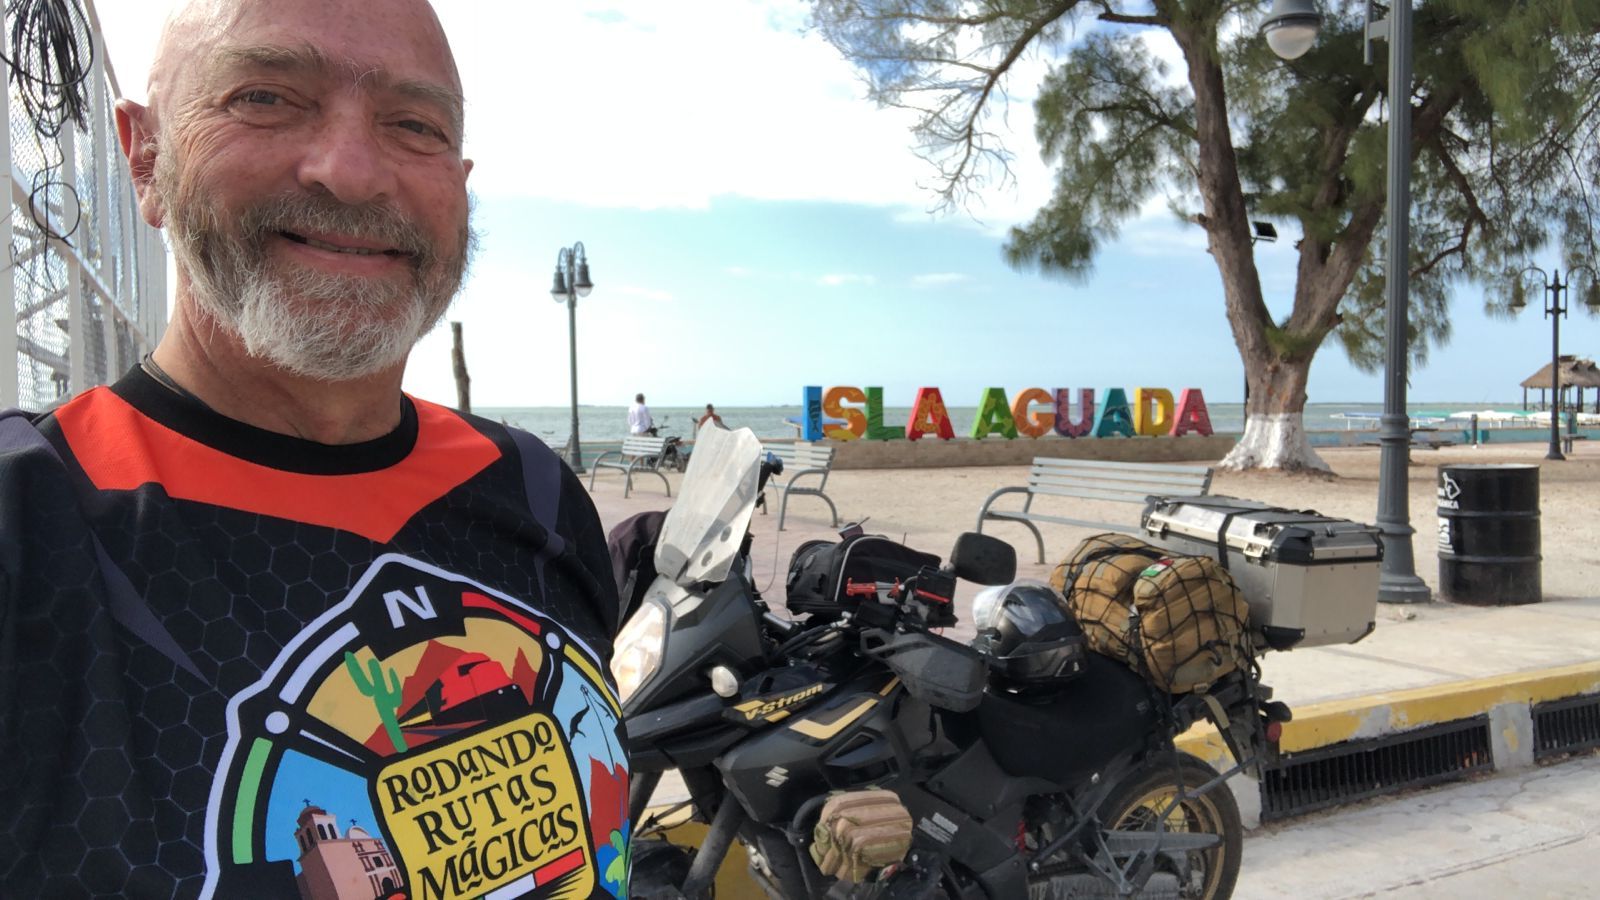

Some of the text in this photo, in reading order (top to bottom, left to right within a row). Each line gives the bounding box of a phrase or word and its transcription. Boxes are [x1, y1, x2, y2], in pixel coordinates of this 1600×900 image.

[802, 386, 1214, 441] ISLA AGUADA
[382, 585, 438, 629] N
